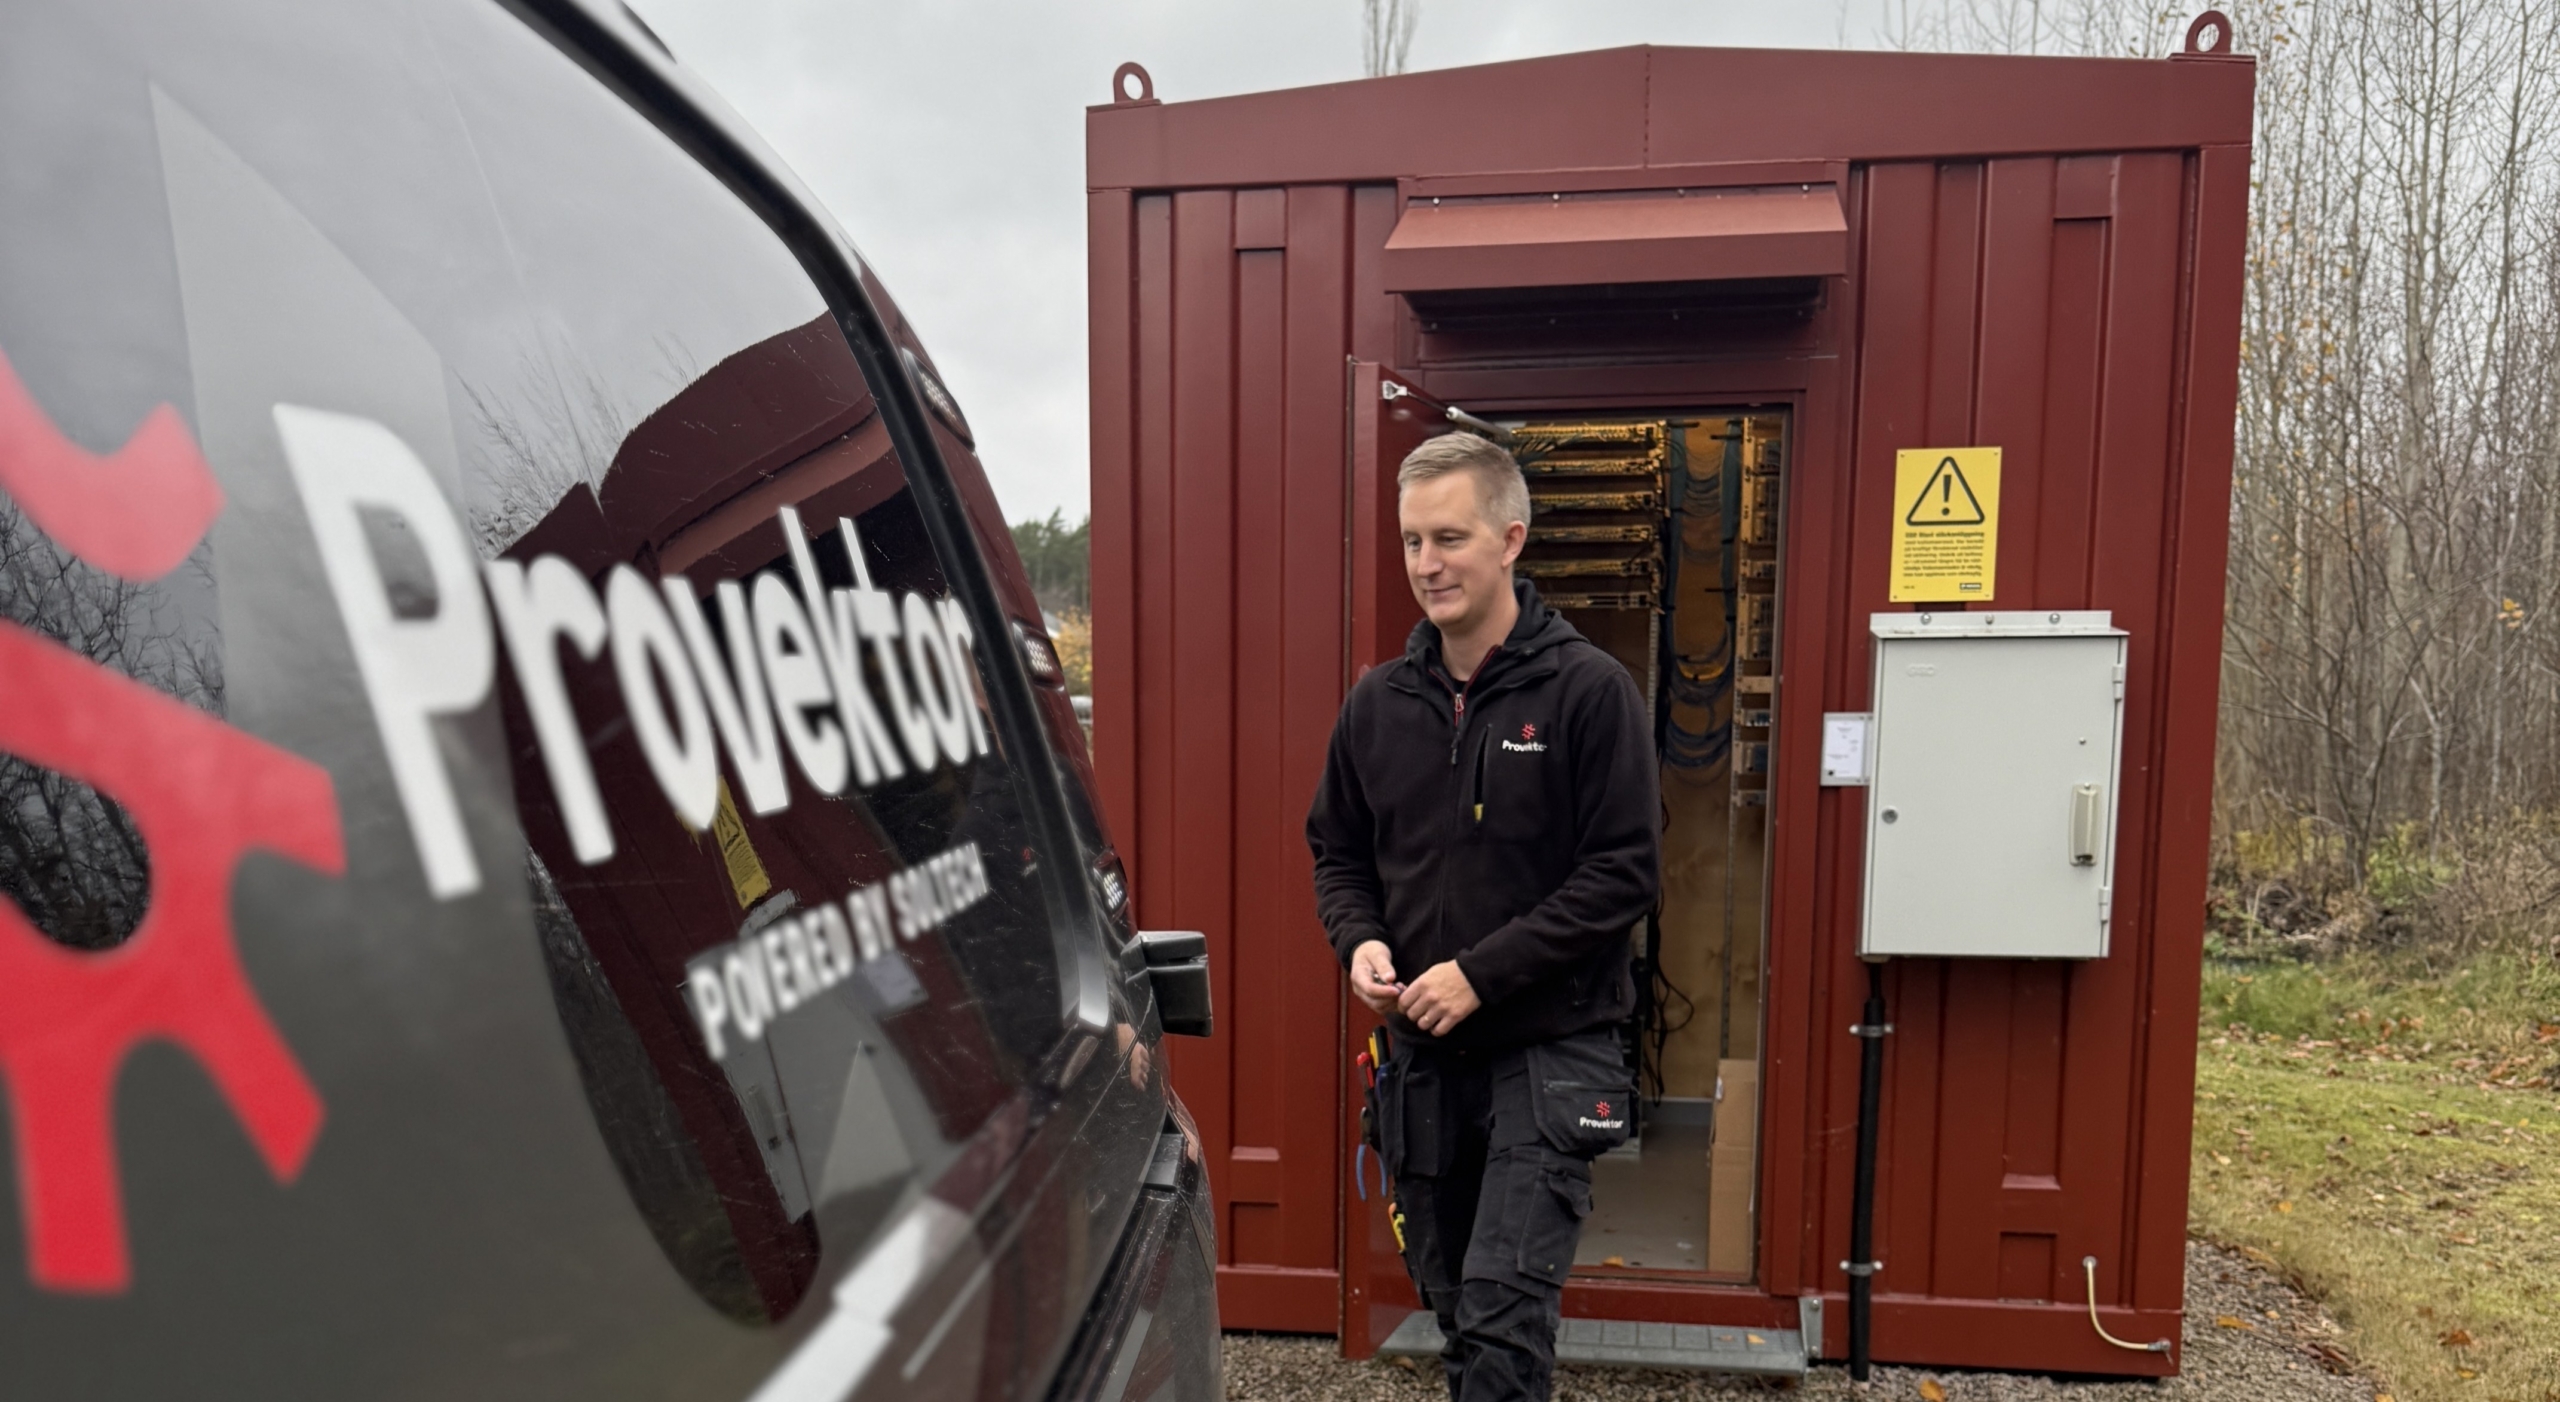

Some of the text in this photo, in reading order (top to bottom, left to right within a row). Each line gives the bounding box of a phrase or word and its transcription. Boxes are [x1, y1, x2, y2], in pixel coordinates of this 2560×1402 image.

[274, 402, 990, 900] Provektor
[690, 842, 987, 1060] POWERED BY SOLTECH
[1579, 1116, 1623, 1129] Provektor
